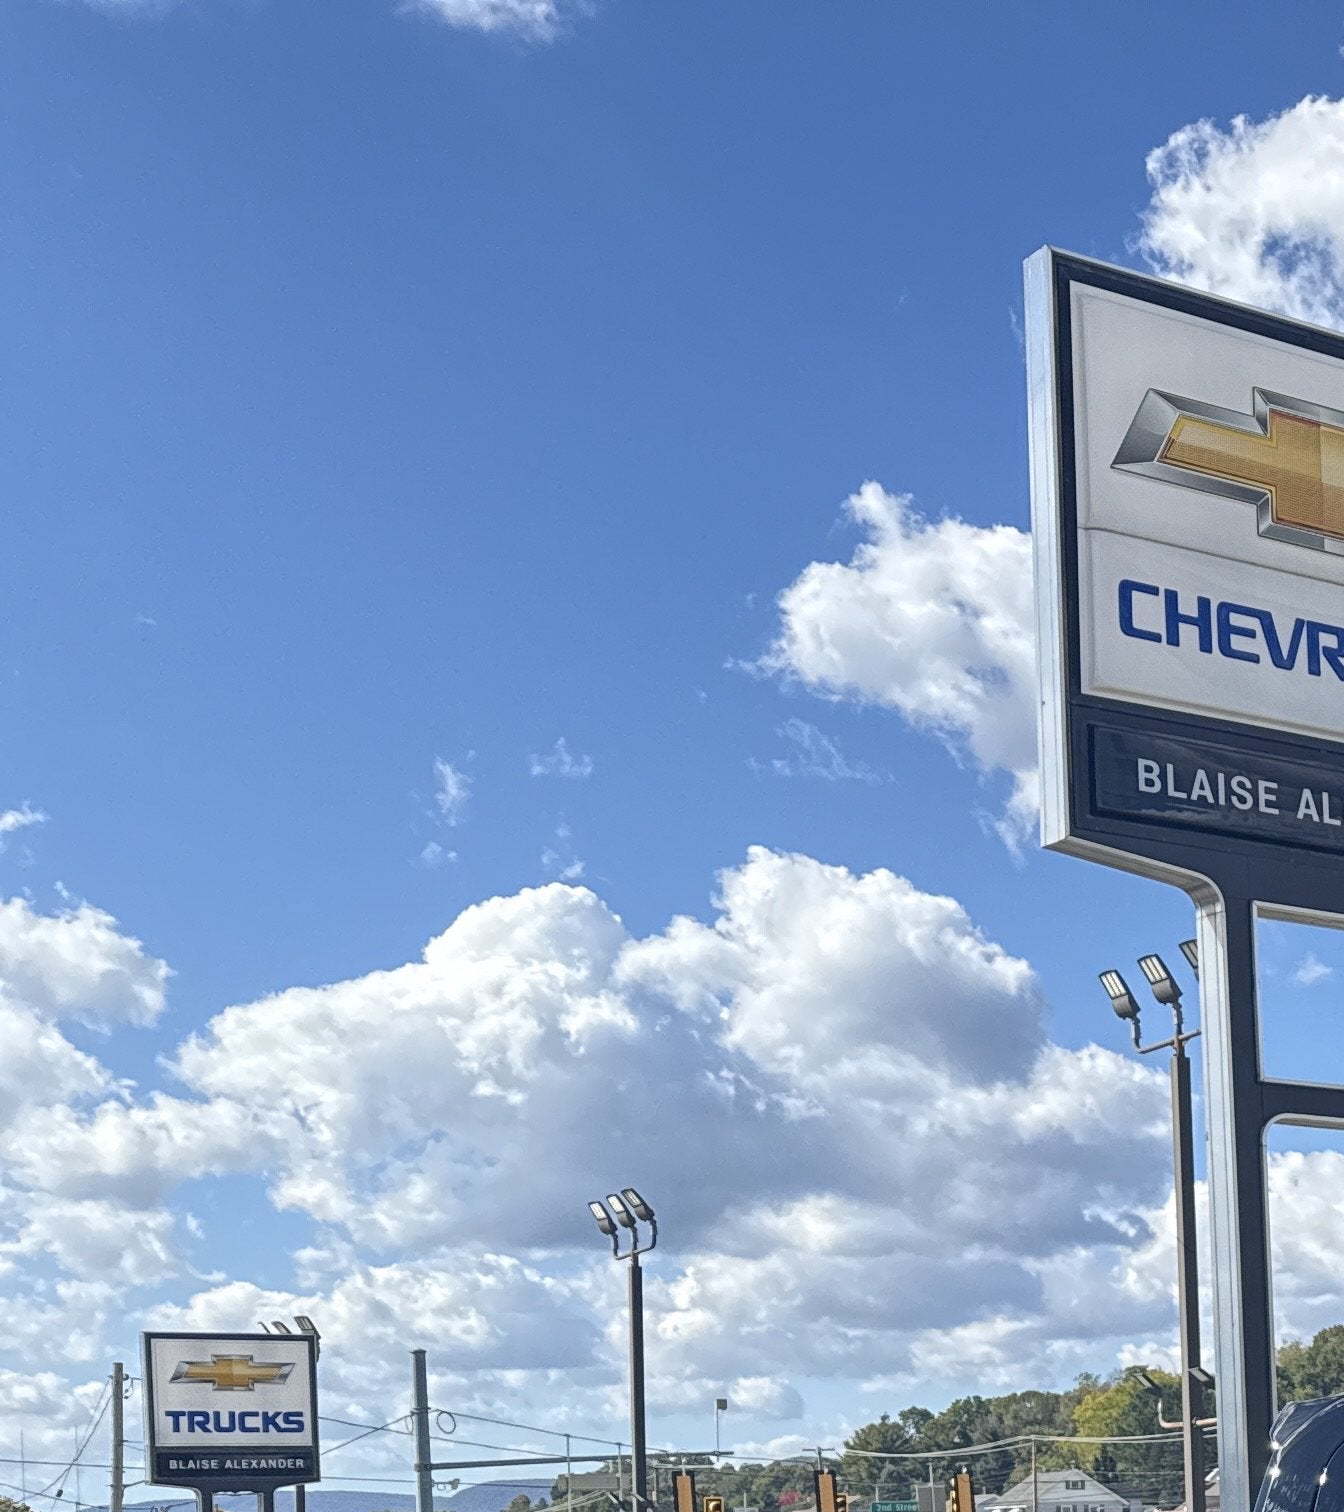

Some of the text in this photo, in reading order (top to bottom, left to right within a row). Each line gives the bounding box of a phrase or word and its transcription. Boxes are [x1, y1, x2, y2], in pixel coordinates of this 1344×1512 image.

[1137, 757, 1280, 815] BLAISE
[165, 1410, 305, 1433] TRUCKS
[169, 1458, 304, 1470] BLAISE ALEXANDER
[876, 1503, 918, 1512] 2nd Stree
